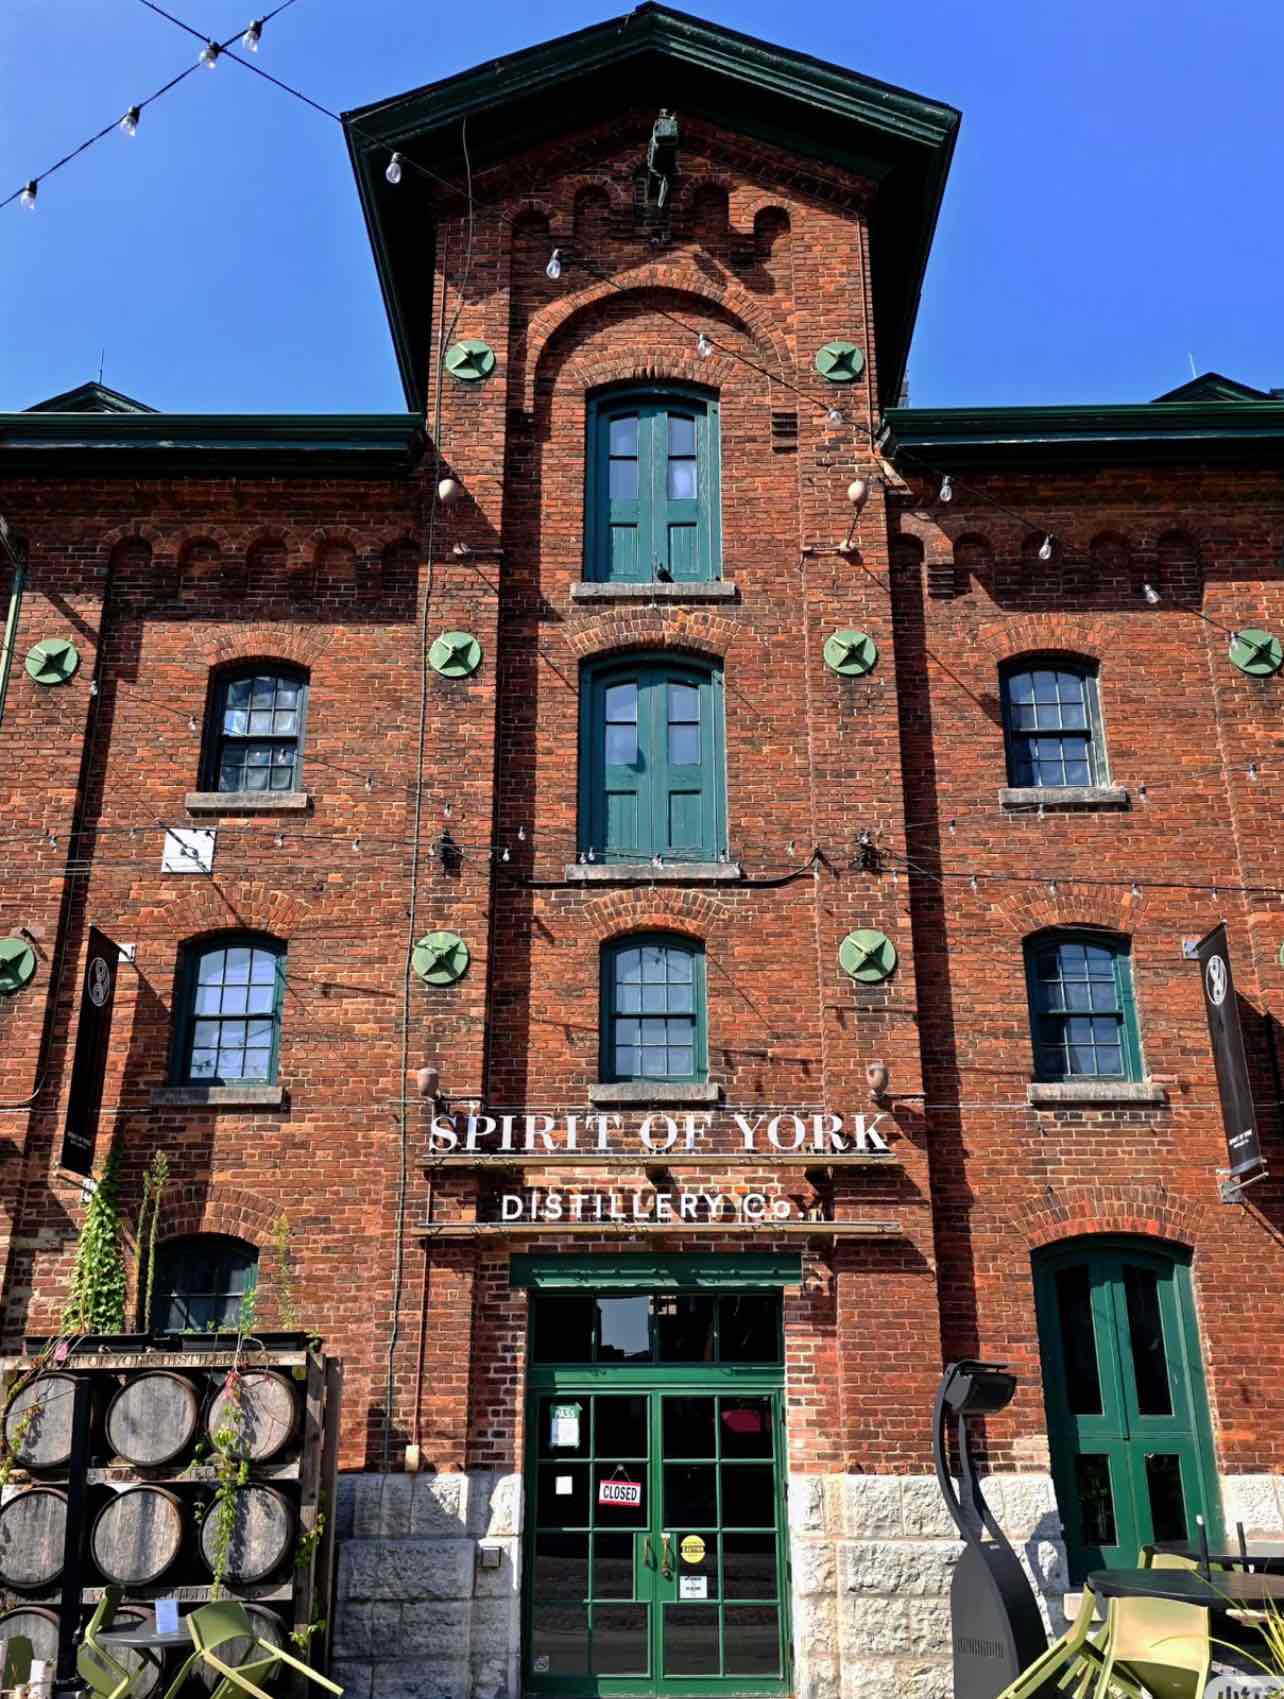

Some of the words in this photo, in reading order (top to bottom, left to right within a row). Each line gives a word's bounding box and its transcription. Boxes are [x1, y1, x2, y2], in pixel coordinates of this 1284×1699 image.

[429, 1113, 622, 1151] SPIRIT
[639, 1112, 712, 1151] OF
[731, 1112, 889, 1151] YORK
[502, 1192, 722, 1220] DISTILLERY
[603, 1485, 637, 1501] CLOSED
